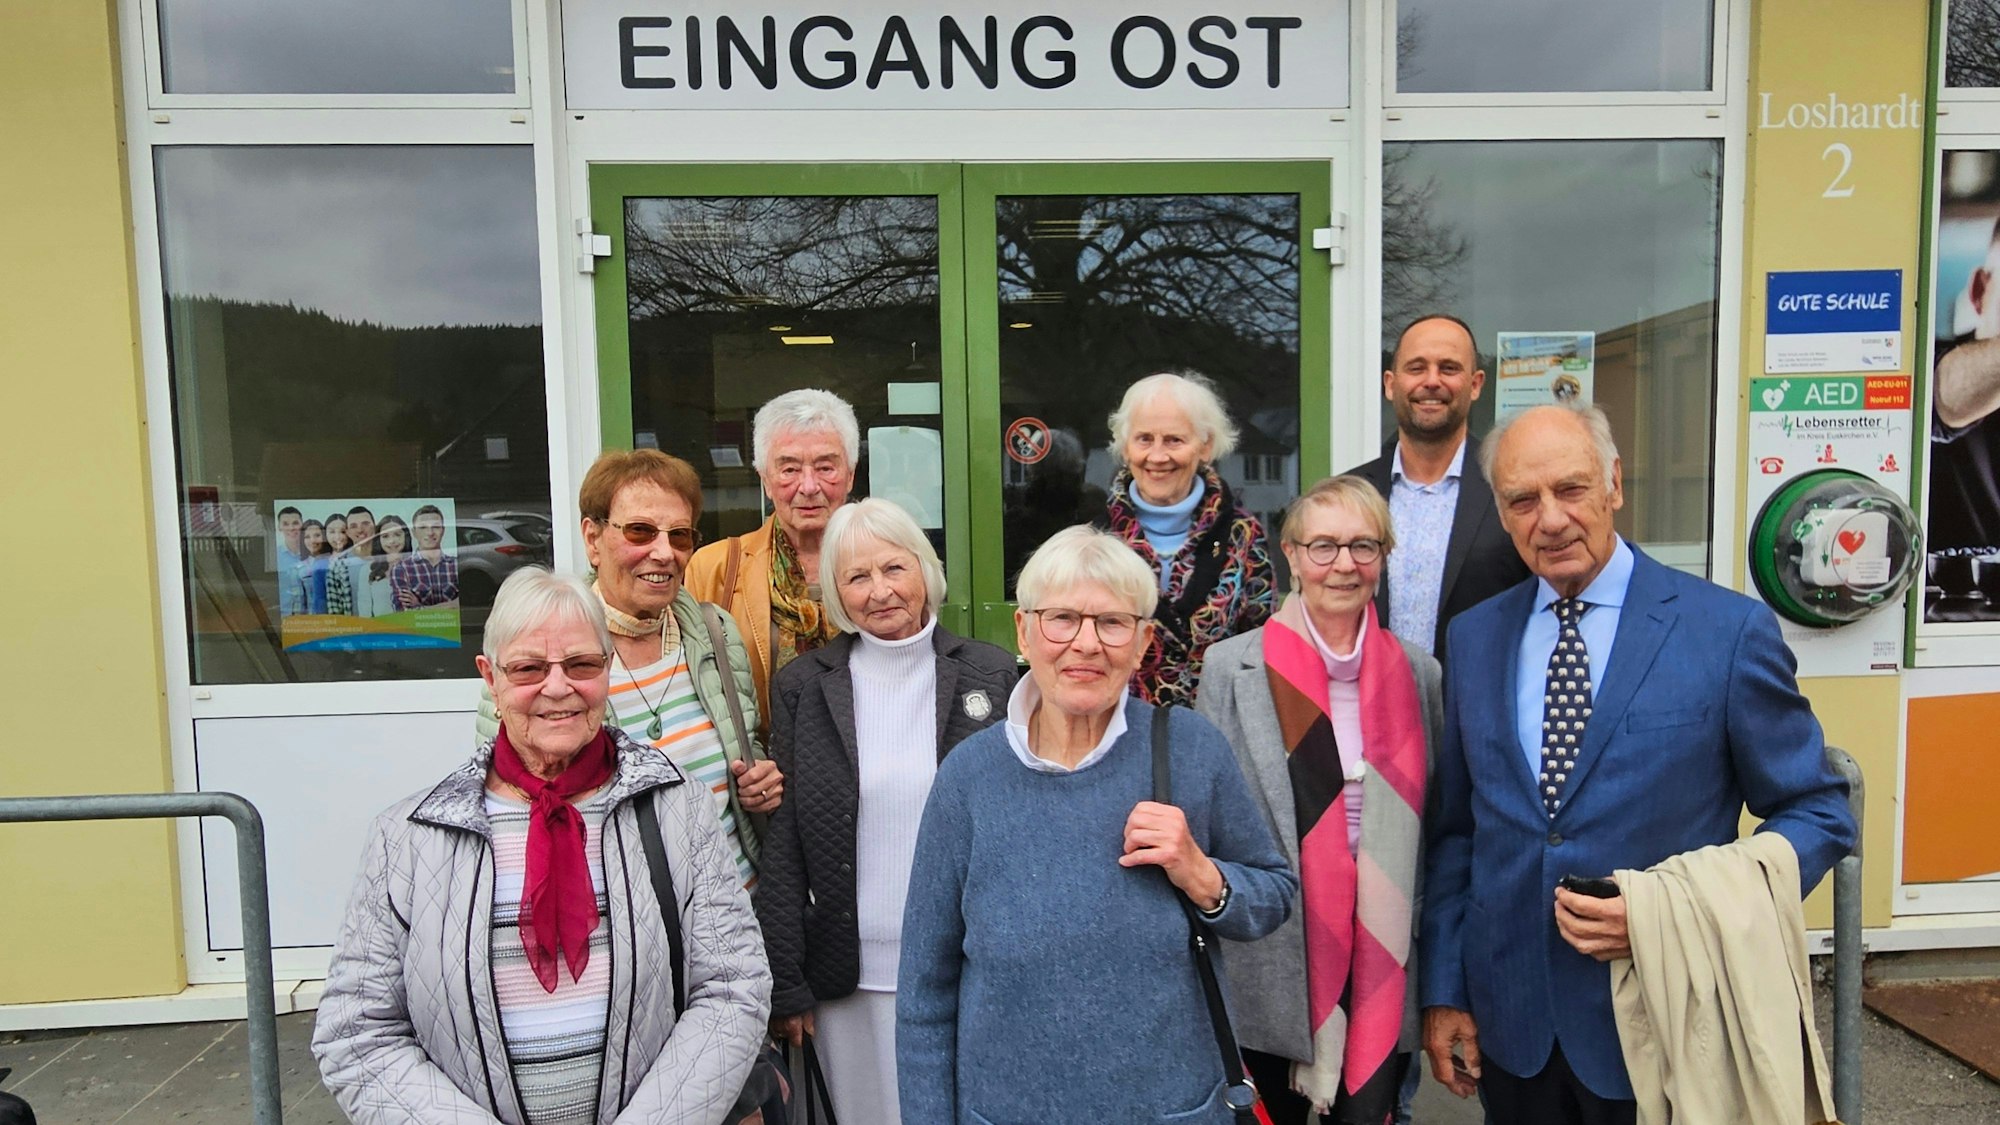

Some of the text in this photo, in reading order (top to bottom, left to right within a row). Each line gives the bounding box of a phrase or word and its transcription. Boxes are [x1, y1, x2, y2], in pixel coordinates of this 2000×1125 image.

[619, 15, 1302, 90] EINGANG OST
[1758, 92, 1921, 129] Loshardt
[1822, 142, 1855, 198] 2
[1778, 292, 1891, 311] GUTE SCHULE
[1867, 380, 1908, 389] AED-EU-011
[1804, 382, 1858, 405] AED
[1870, 395, 1905, 404] Notruf 112
[1796, 416, 1882, 428] Lebensretter
[1807, 432, 1825, 440] Kreis
[1815, 444, 1821, 452] 2
